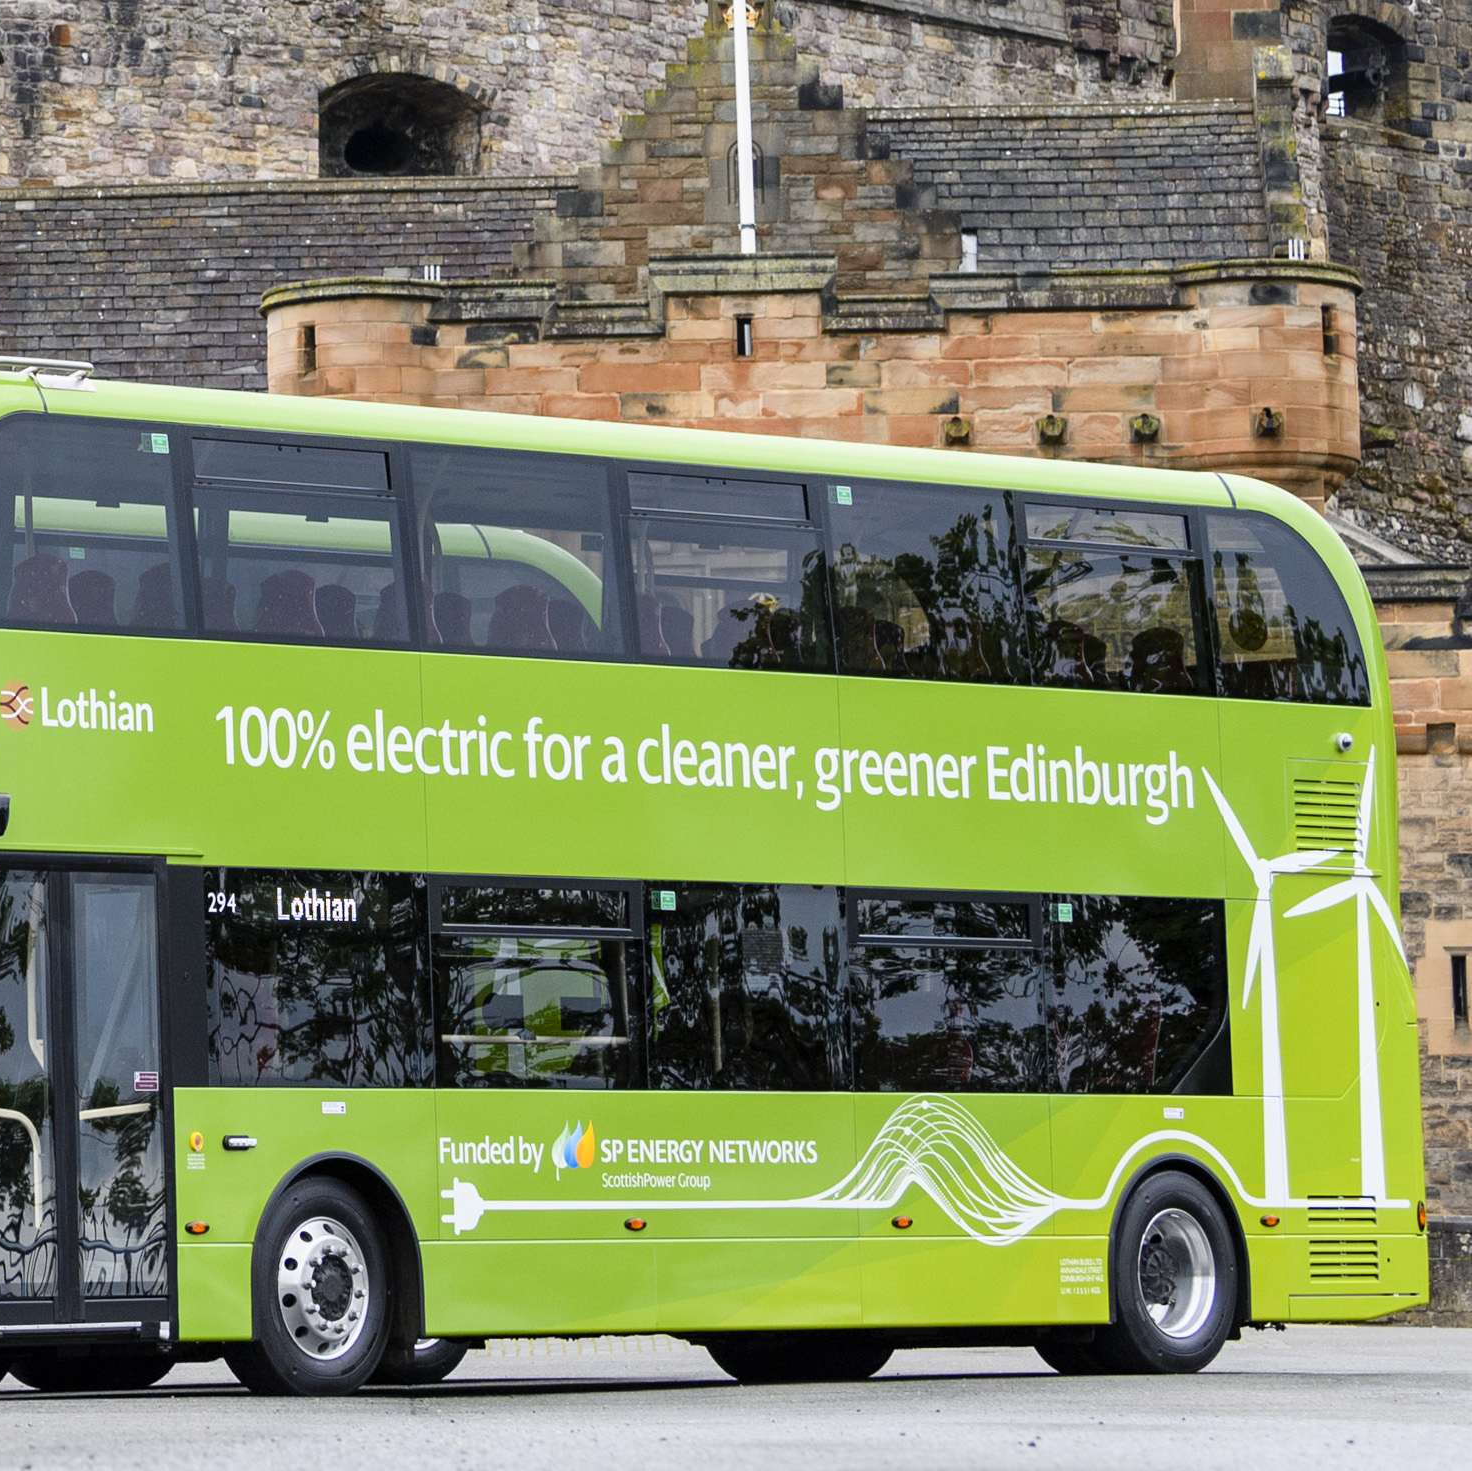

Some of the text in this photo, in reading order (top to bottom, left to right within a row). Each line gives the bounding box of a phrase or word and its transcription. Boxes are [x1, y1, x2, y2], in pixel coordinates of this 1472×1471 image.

[41, 686, 154, 732] Lothian
[215, 705, 1195, 825] 100% electric for a cleaner, greener Edinburgh
[207, 891, 237, 913] 294
[276, 887, 357, 922] Lothian
[439, 1136, 818, 1173] Funded by SP ENERGY NETWORKS
[602, 1173, 711, 1190] ScottishPower Group
